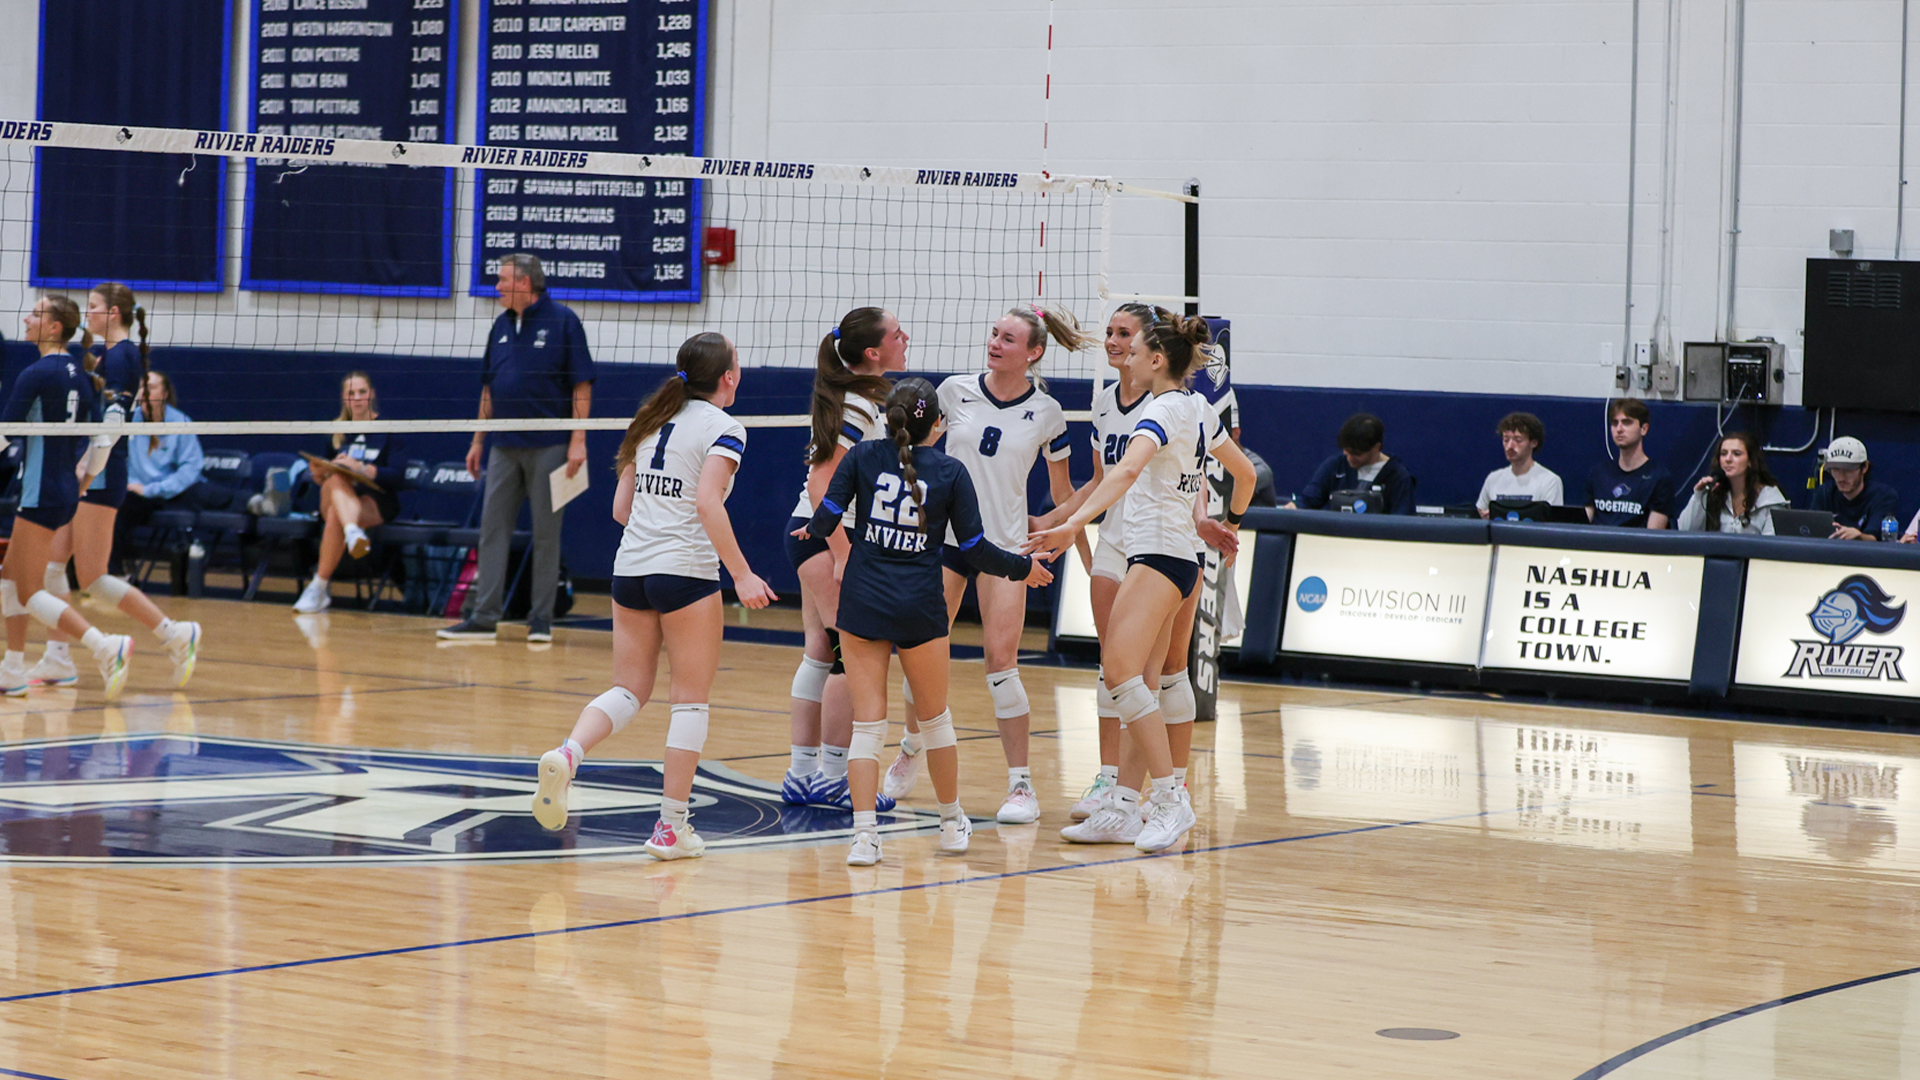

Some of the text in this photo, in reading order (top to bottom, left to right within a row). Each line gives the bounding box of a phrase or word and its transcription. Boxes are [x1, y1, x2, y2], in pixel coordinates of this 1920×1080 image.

[493, 15, 692, 32] 2010 BLAIR CARPENTER 1,228
[492, 44, 522, 59] 2010
[527, 44, 554, 59] JESS
[555, 44, 599, 59] MELLEN
[491, 70, 690, 87] 2010 MONICA WHITE 1,033
[490, 98, 521, 113] 2012
[582, 98, 627, 113] PURCELL
[655, 98, 689, 115] 1,166
[195, 132, 335, 156] RIVIER RAIDERS
[488, 125, 688, 142] 2015 DEANNA PURCELL 2,192
[461, 147, 589, 168] RIVIER RAIDERS
[701, 159, 814, 180] RIVIER RAIDERS
[916, 170, 1018, 187] RIVIER RAIDERS
[488, 179, 518, 194] 2017
[487, 206, 517, 221] 2019
[653, 208, 685, 226] 1,740
[1021, 410, 1035, 421] R
[650, 422, 676, 470] 1
[979, 426, 1002, 457] 8
[1104, 433, 1130, 465] 20
[870, 471, 928, 527] 22
[1594, 499, 1644, 515] TOGETHER.
[1198, 453, 1225, 694] RADERS
[1526, 565, 1652, 590] NASHUA
[1299, 593, 1327, 604] NCAA
[1341, 587, 1466, 614] DIVISION III
[1523, 590, 1580, 611] IS A
[1340, 610, 1377, 618] DISCOVER
[1425, 616, 1463, 625] DEDICATE
[1520, 615, 1647, 641] COLLEGE
[1517, 640, 1611, 664] TOWN.
[1780, 638, 1908, 682] RIVIER
[1824, 667, 1867, 676] BASKETBALL
